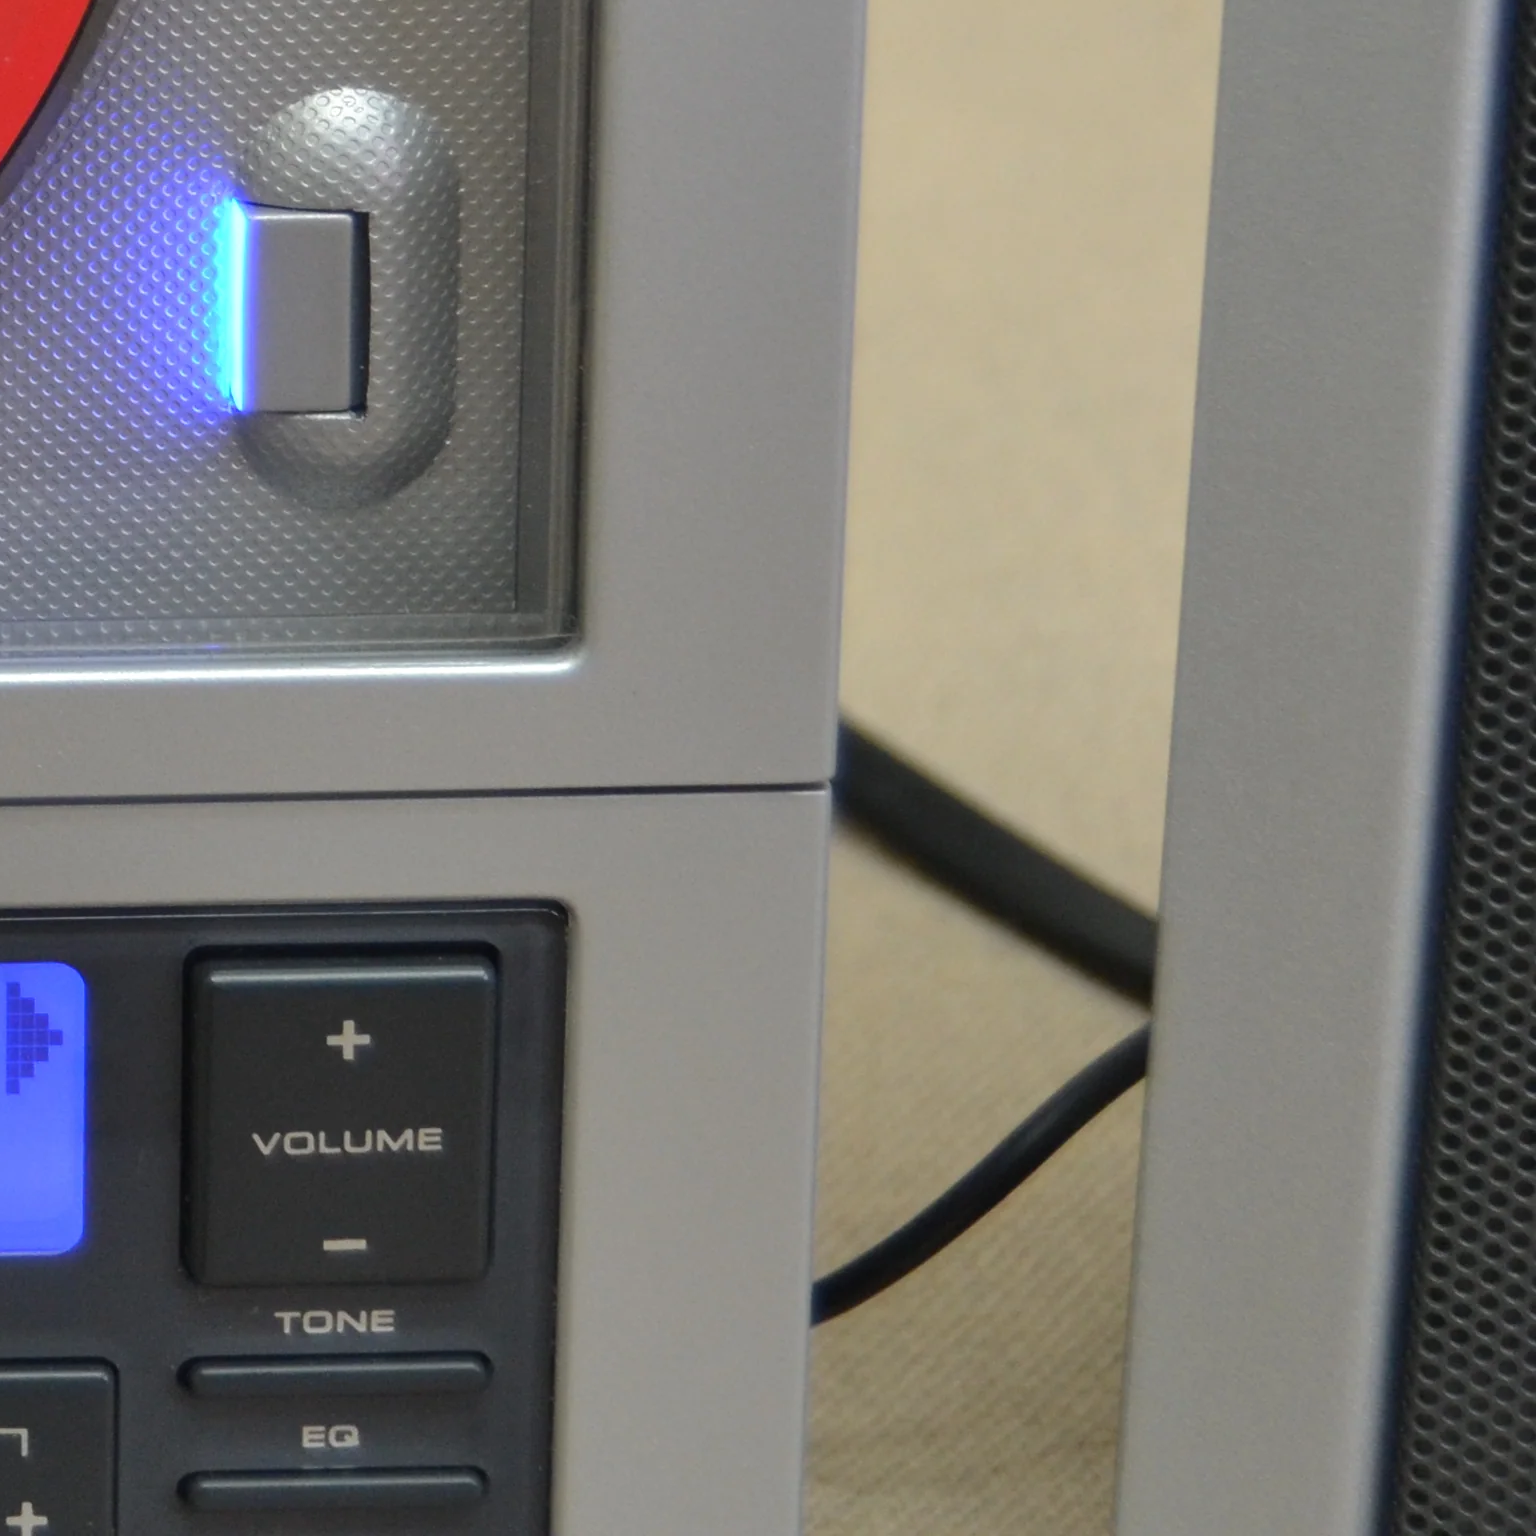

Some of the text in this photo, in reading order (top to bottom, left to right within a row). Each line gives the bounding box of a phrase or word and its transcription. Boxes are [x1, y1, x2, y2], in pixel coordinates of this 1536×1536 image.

[251, 1127, 443, 1156] VOLUME
[273, 1309, 396, 1336] TONE
[301, 1424, 361, 1450] EQ
